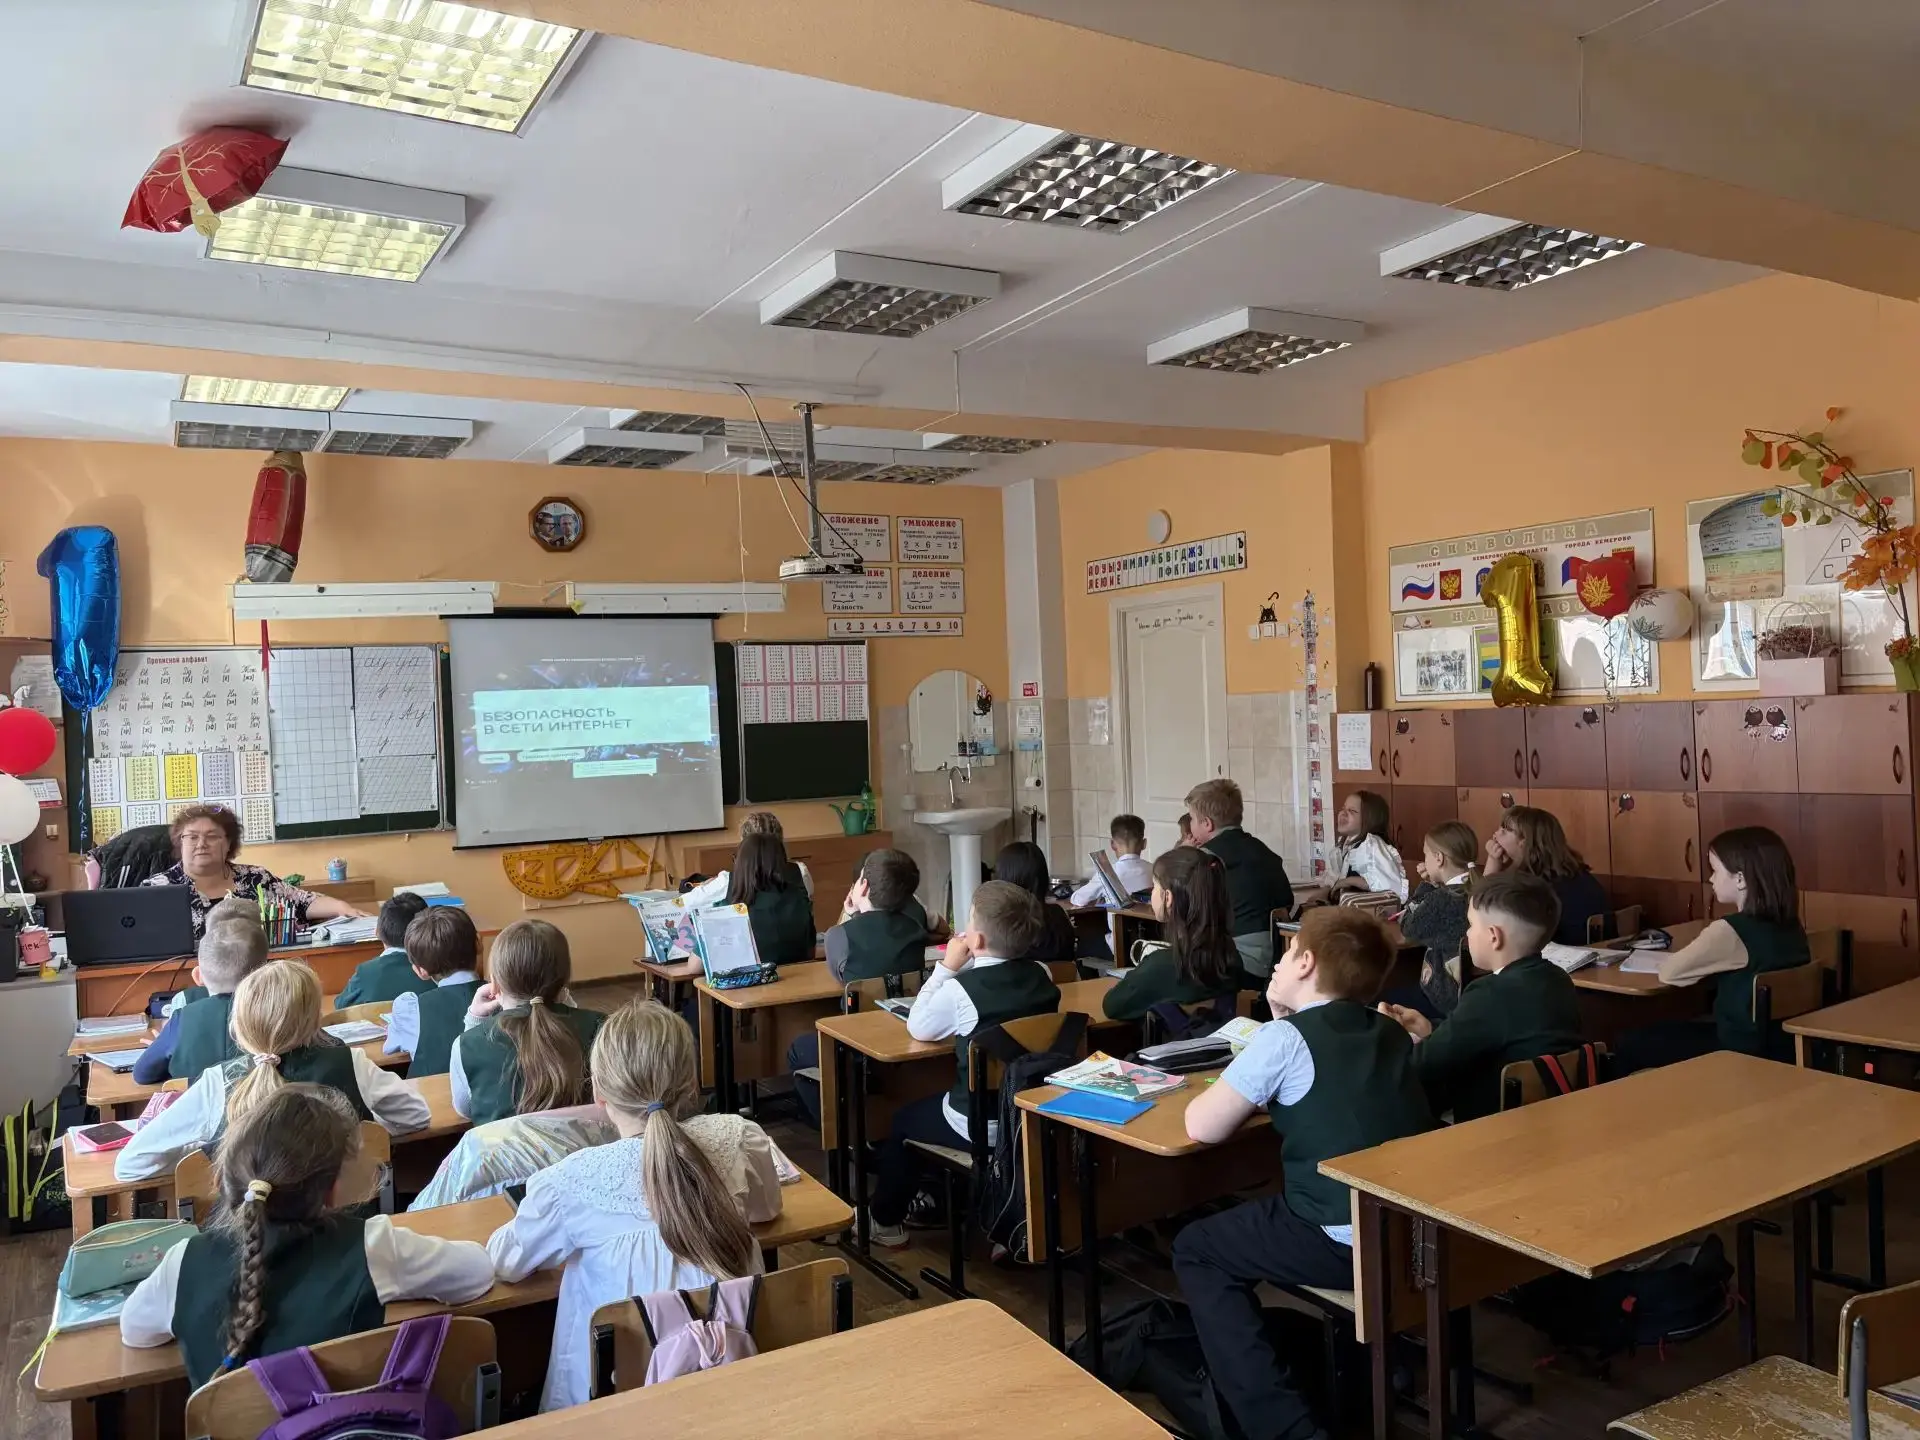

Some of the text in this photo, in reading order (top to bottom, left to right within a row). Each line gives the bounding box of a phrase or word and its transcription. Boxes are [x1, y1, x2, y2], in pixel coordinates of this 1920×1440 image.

[830, 516, 879, 524] сложение
[904, 519, 957, 528] умножение
[1430, 523, 1599, 557] СИМВОЛИКА
[1595, 536, 1632, 544] КЕМЕРОВО
[912, 570, 950, 578] деление
[834, 622, 837, 630] 1
[846, 622, 851, 630] 2
[860, 622, 864, 630] 3
[873, 622, 878, 630] 4
[899, 622, 904, 630] 6
[182, 656, 208, 664] алфавит
[483, 708, 616, 722] БЕЗОПАСНОСТЬ
[484, 719, 632, 735] В СЕТИ ИНТЕРНЕТ
